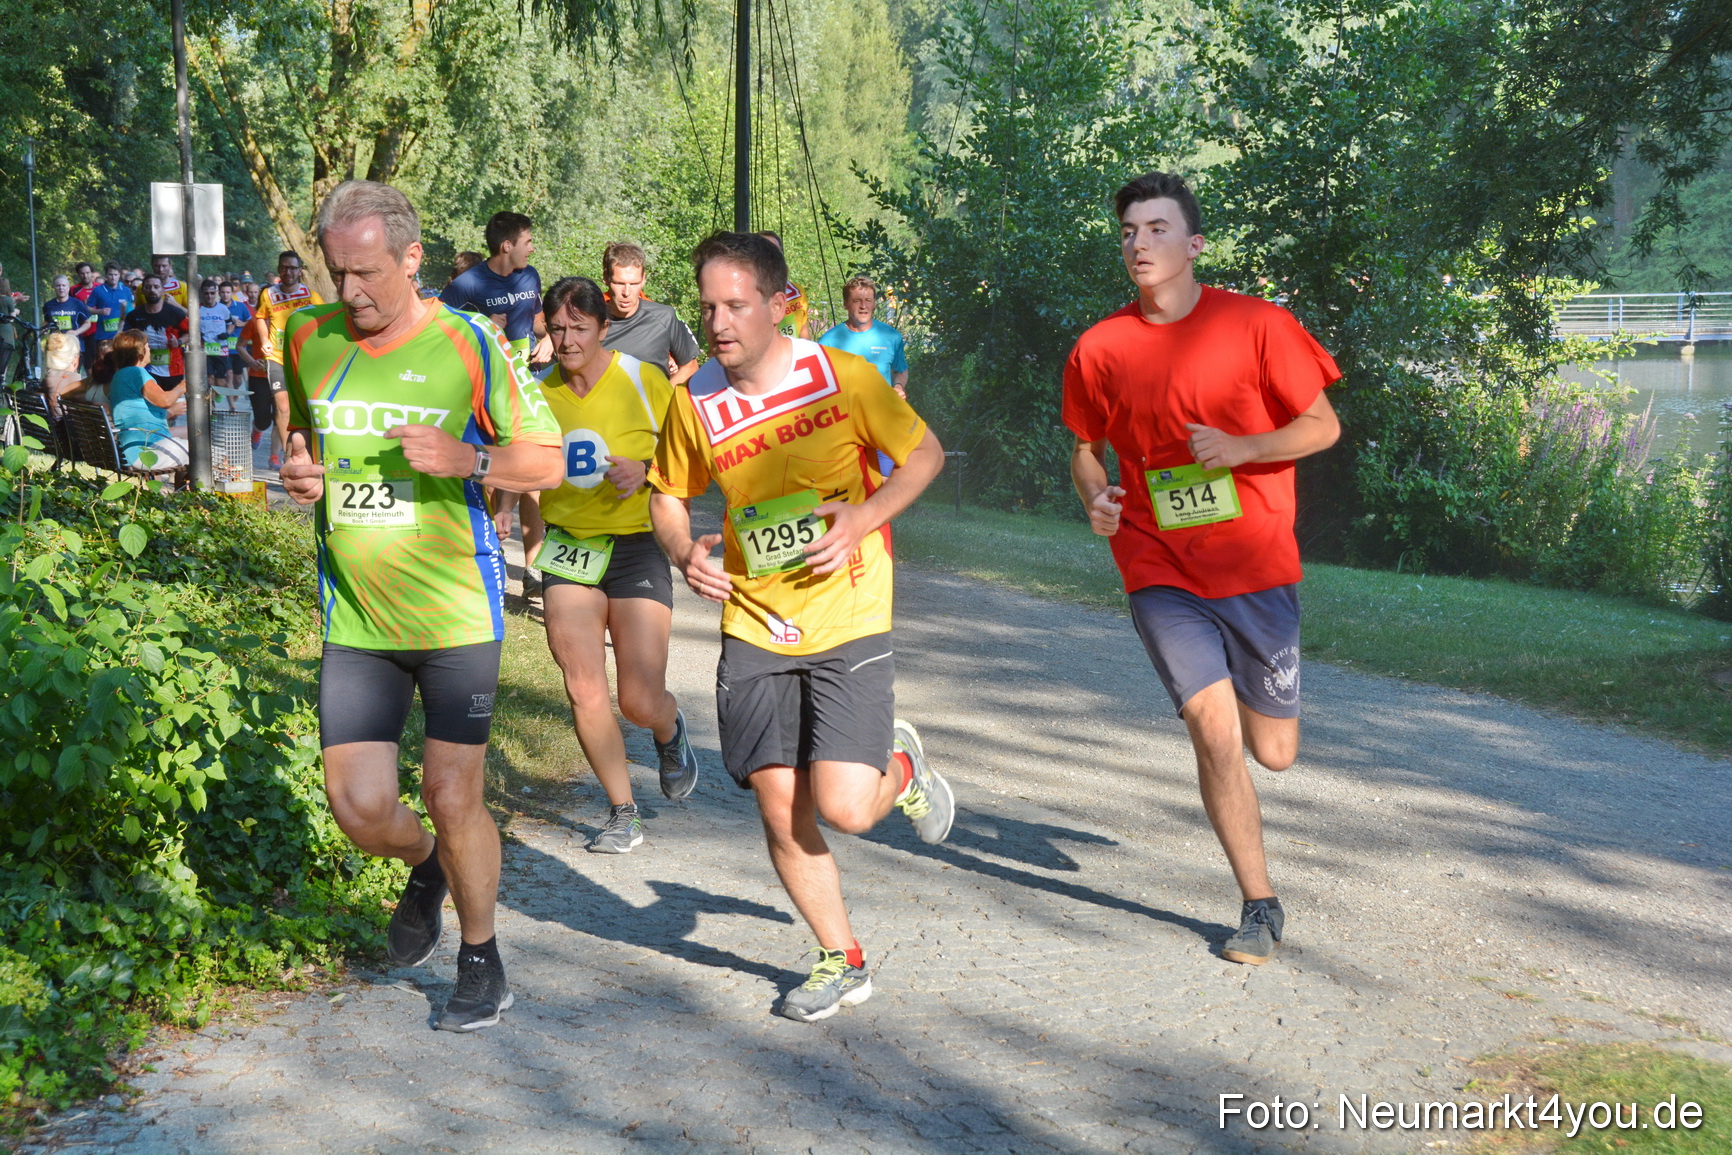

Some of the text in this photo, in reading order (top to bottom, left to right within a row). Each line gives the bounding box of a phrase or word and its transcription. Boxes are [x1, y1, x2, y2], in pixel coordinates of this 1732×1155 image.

[307, 399, 451, 437] BOCK
[714, 405, 849, 473] MAX BÖGL
[567, 440, 597, 477] B
[341, 483, 396, 509] 223
[1169, 483, 1217, 510] 514
[338, 509, 404, 519] Reisinger Helmuth
[747, 517, 814, 555] 1295
[552, 544, 591, 570] 241
[765, 553, 781, 561] Grad
